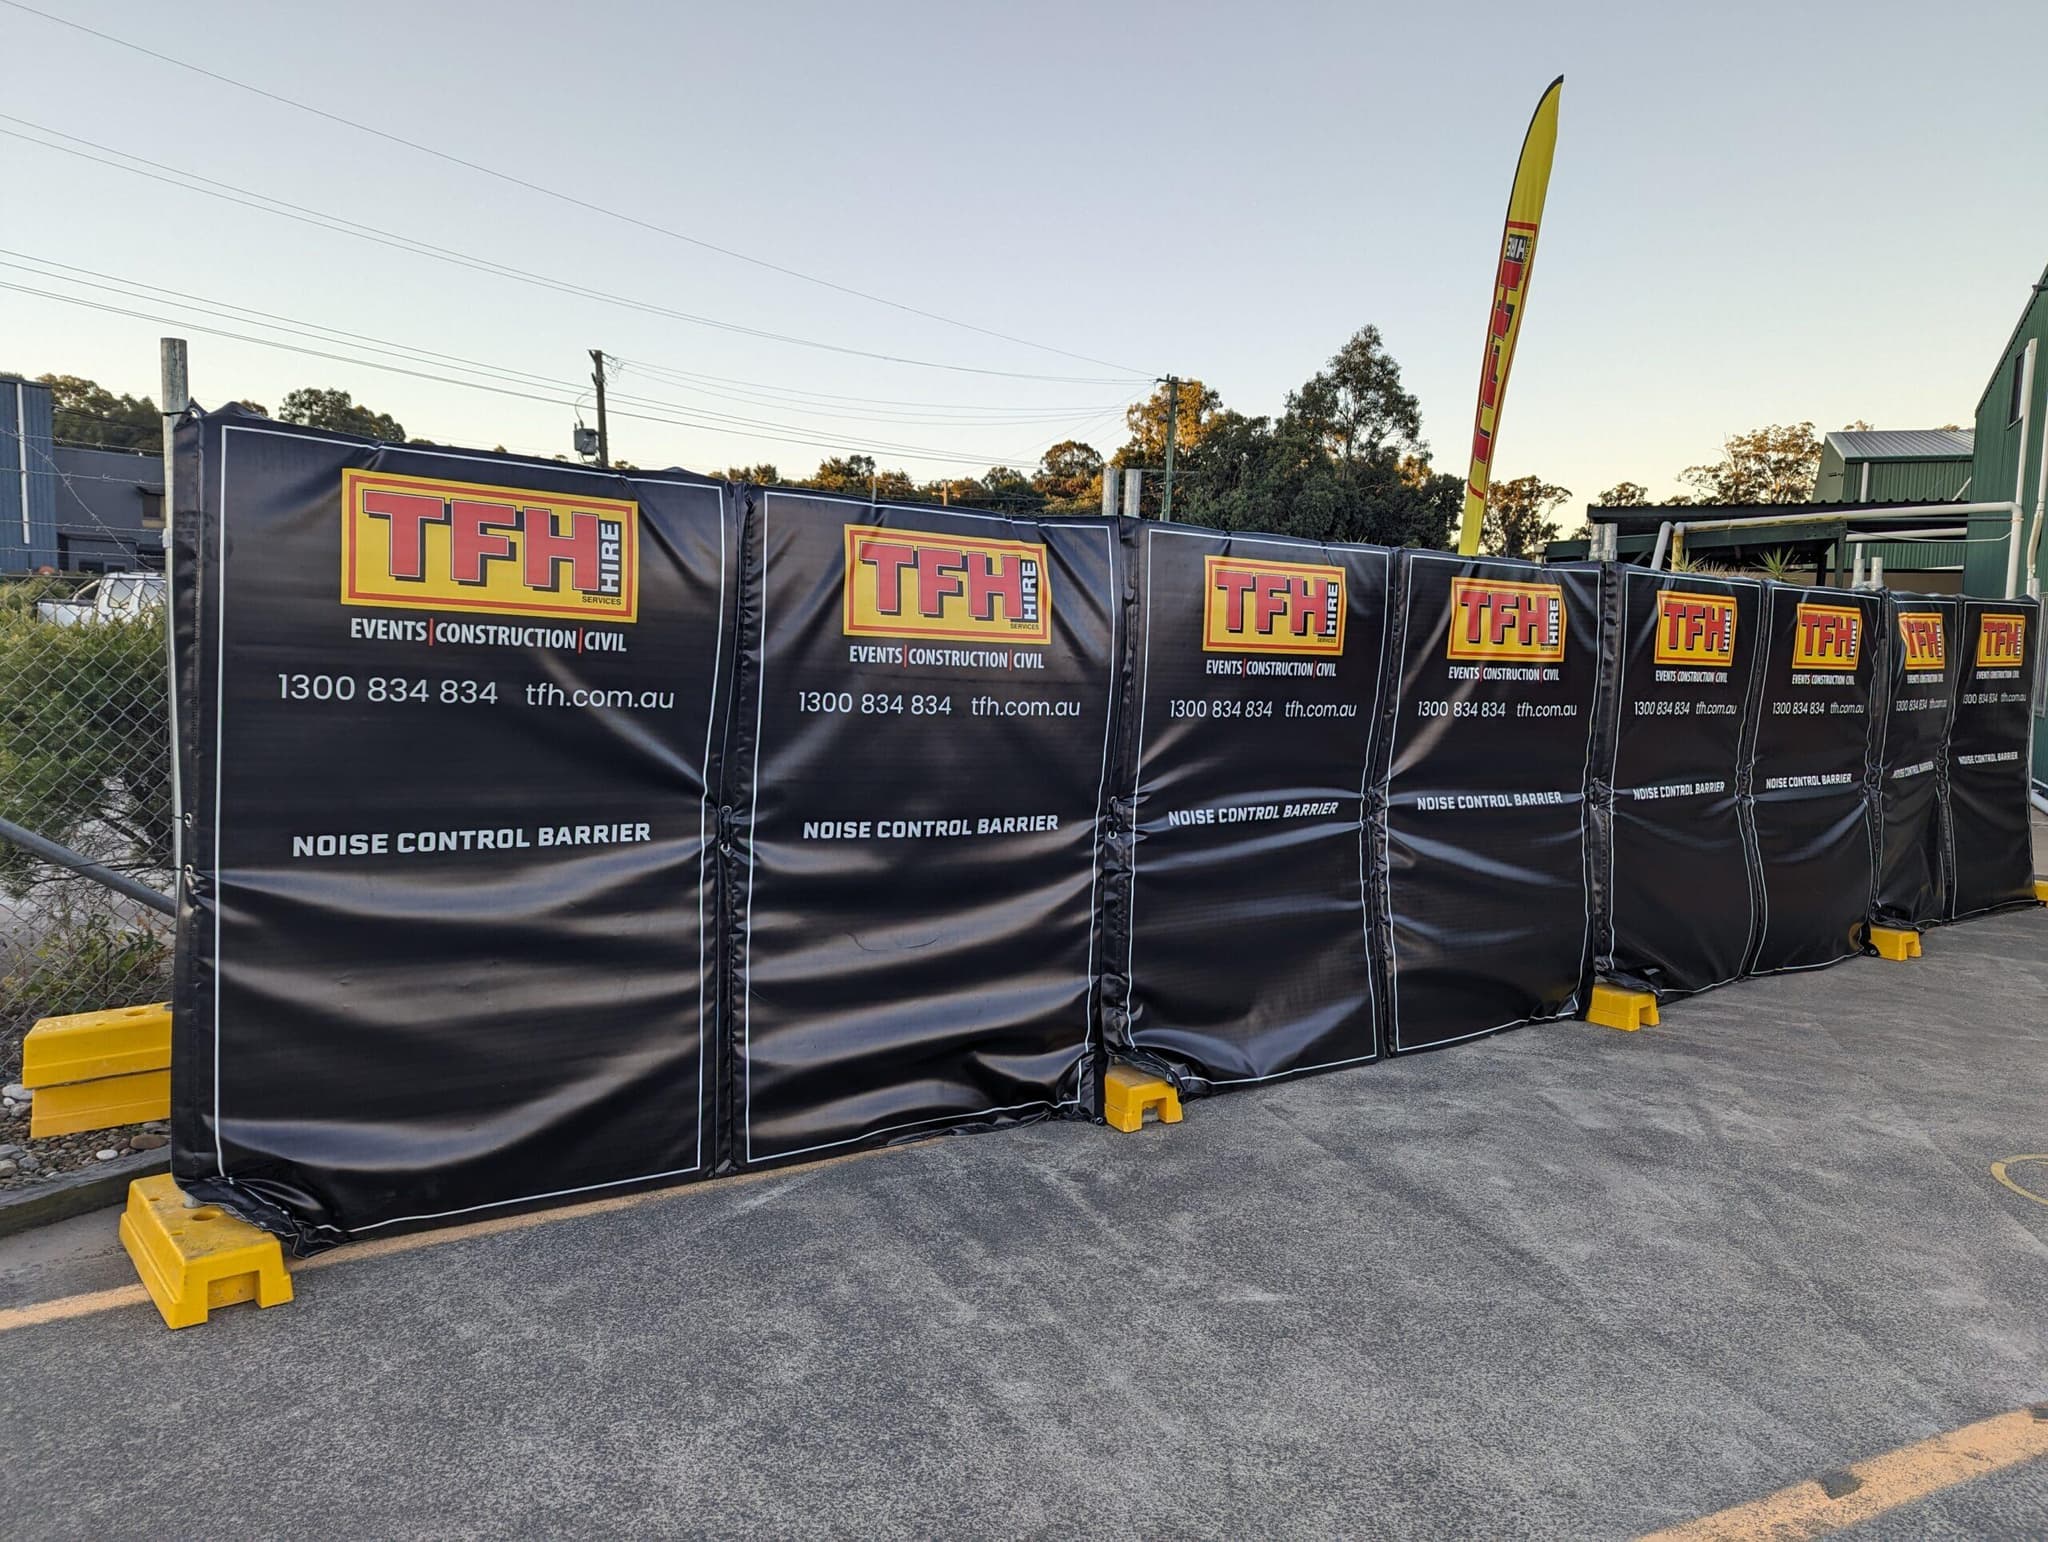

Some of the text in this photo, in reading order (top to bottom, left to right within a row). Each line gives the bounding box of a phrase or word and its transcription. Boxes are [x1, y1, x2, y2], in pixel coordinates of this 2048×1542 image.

[363, 489, 604, 593] TFH
[600, 522, 621, 594] HIRE
[859, 540, 1023, 621] TFH
[1022, 560, 1038, 621] HIRE
[581, 595, 623, 607] SERVICES
[1215, 568, 1328, 636] TFH
[1326, 582, 1338, 636] HIRE
[1009, 622, 1040, 632] SERVICES
[1461, 589, 1550, 646] TFH
[1549, 597, 1560, 646] HIRE
[1664, 602, 1725, 652] TFH
[350, 617, 628, 653] EVENTS CONSTRUCTION CIVIL
[1801, 613, 1851, 657] TFH
[1983, 621, 2019, 657] TFH
[849, 645, 1045, 670] EVENTS CONSTRUCTION CIVIL
[1206, 659, 1337, 678] EVENTS CONSTRUCTION CIVIL
[1448, 666, 1560, 682] EVENTS CONSTRUCTION CIVIL
[1655, 670, 1677, 682] EVENTS
[277, 673, 675, 709] 1300 834 834 tfh.com.au
[798, 691, 1081, 717] 1300 834 834 tfh.com.au
[1169, 699, 1358, 719] 1300 834 834 tfh.com.au
[1417, 699, 1578, 718] 1300 834 834 tfh.com.au
[1634, 700, 1656, 715] 1300
[1656, 701, 1673, 715] 834
[1674, 701, 1690, 715] 834
[1772, 702, 1792, 715] 1300
[1792, 702, 1809, 715] 834
[1809, 702, 1824, 714] 834
[1632, 780, 1726, 800] NOISE CONTROL BARRIER
[1765, 773, 1852, 789] NOISE CONTROL BARRIER
[1168, 801, 1340, 826] NOISE CONTROL BARRIER
[1417, 790, 1564, 811] NOISE CONTROL BARRIER
[292, 822, 651, 857] NOISE CONTROL BARRIER
[803, 814, 1059, 840] NOISE CONTROL BARRIER
